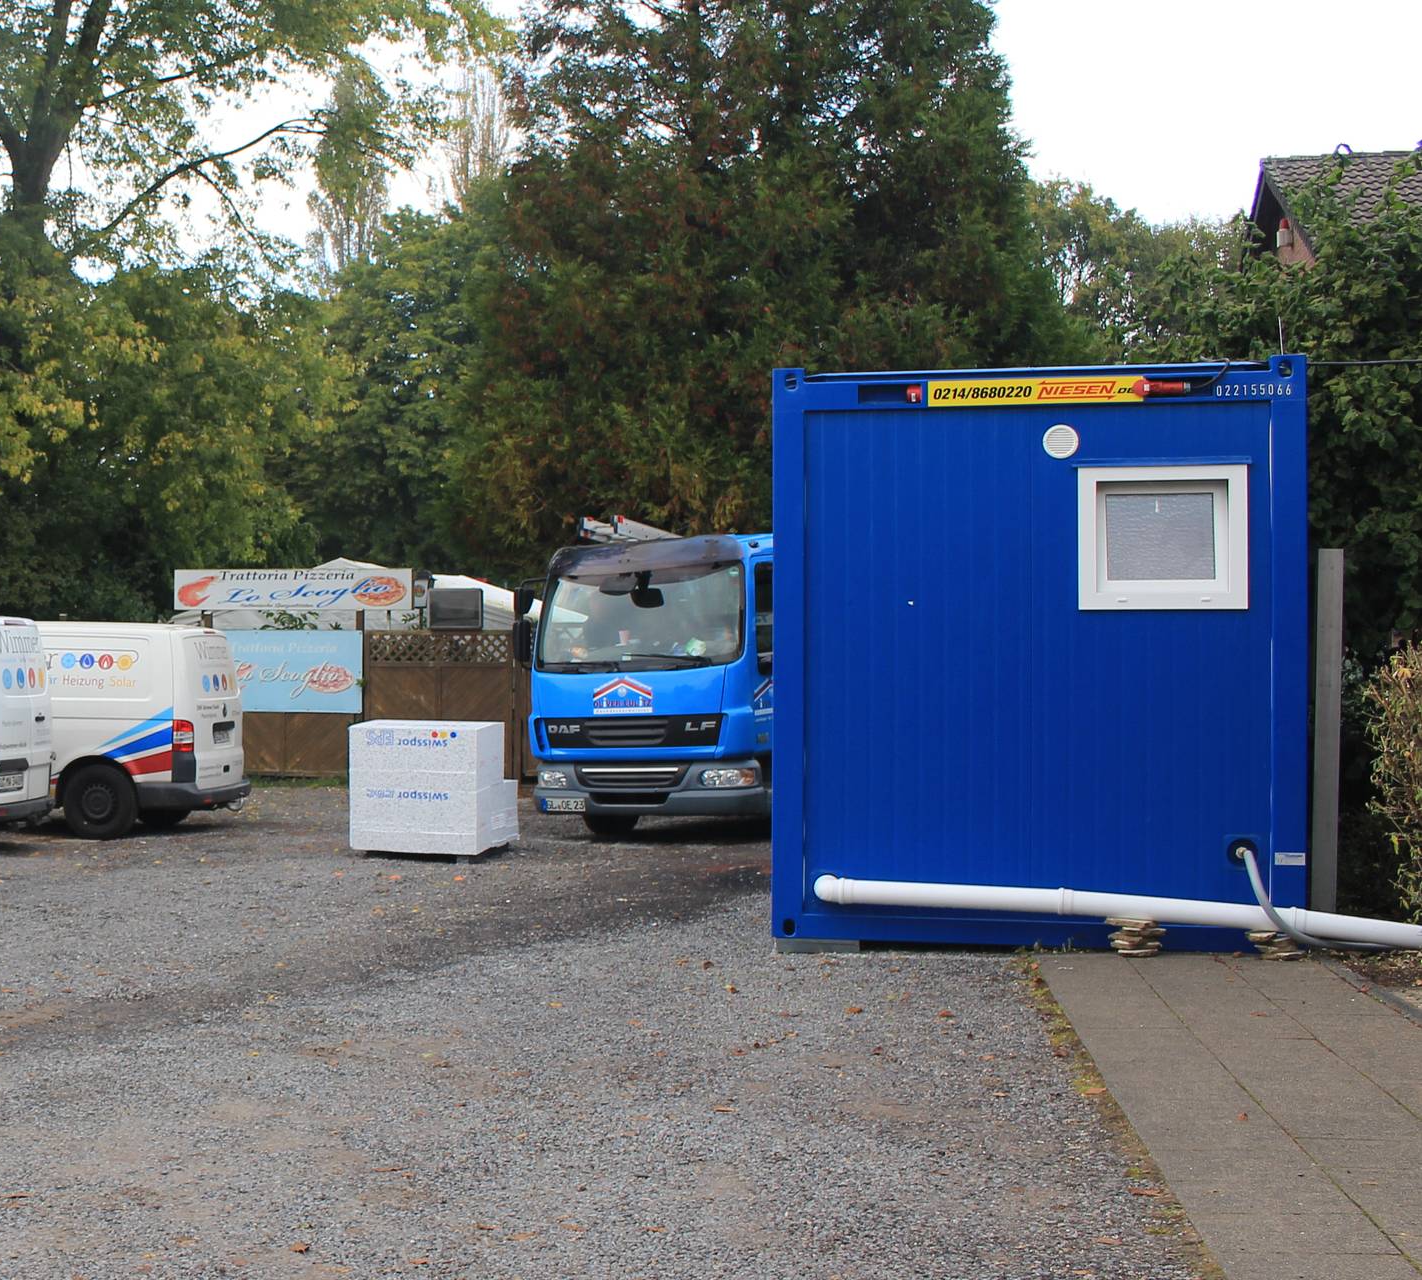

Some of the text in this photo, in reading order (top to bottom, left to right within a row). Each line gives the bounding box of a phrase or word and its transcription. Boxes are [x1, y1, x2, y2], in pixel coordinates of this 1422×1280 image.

[933, 386, 1032, 400] 0214/8680220
[1216, 384, 1291, 397] 022155066
[219, 570, 355, 581] Trattoria Pizzeria
[219, 579, 390, 608] Lo Scoglio
[62, 675, 104, 688] Heizung
[109, 676, 136, 688] Solar
[548, 721, 716, 734] DAF LF
[398, 736, 448, 748] swisspor
[398, 790, 448, 801] swisspor
